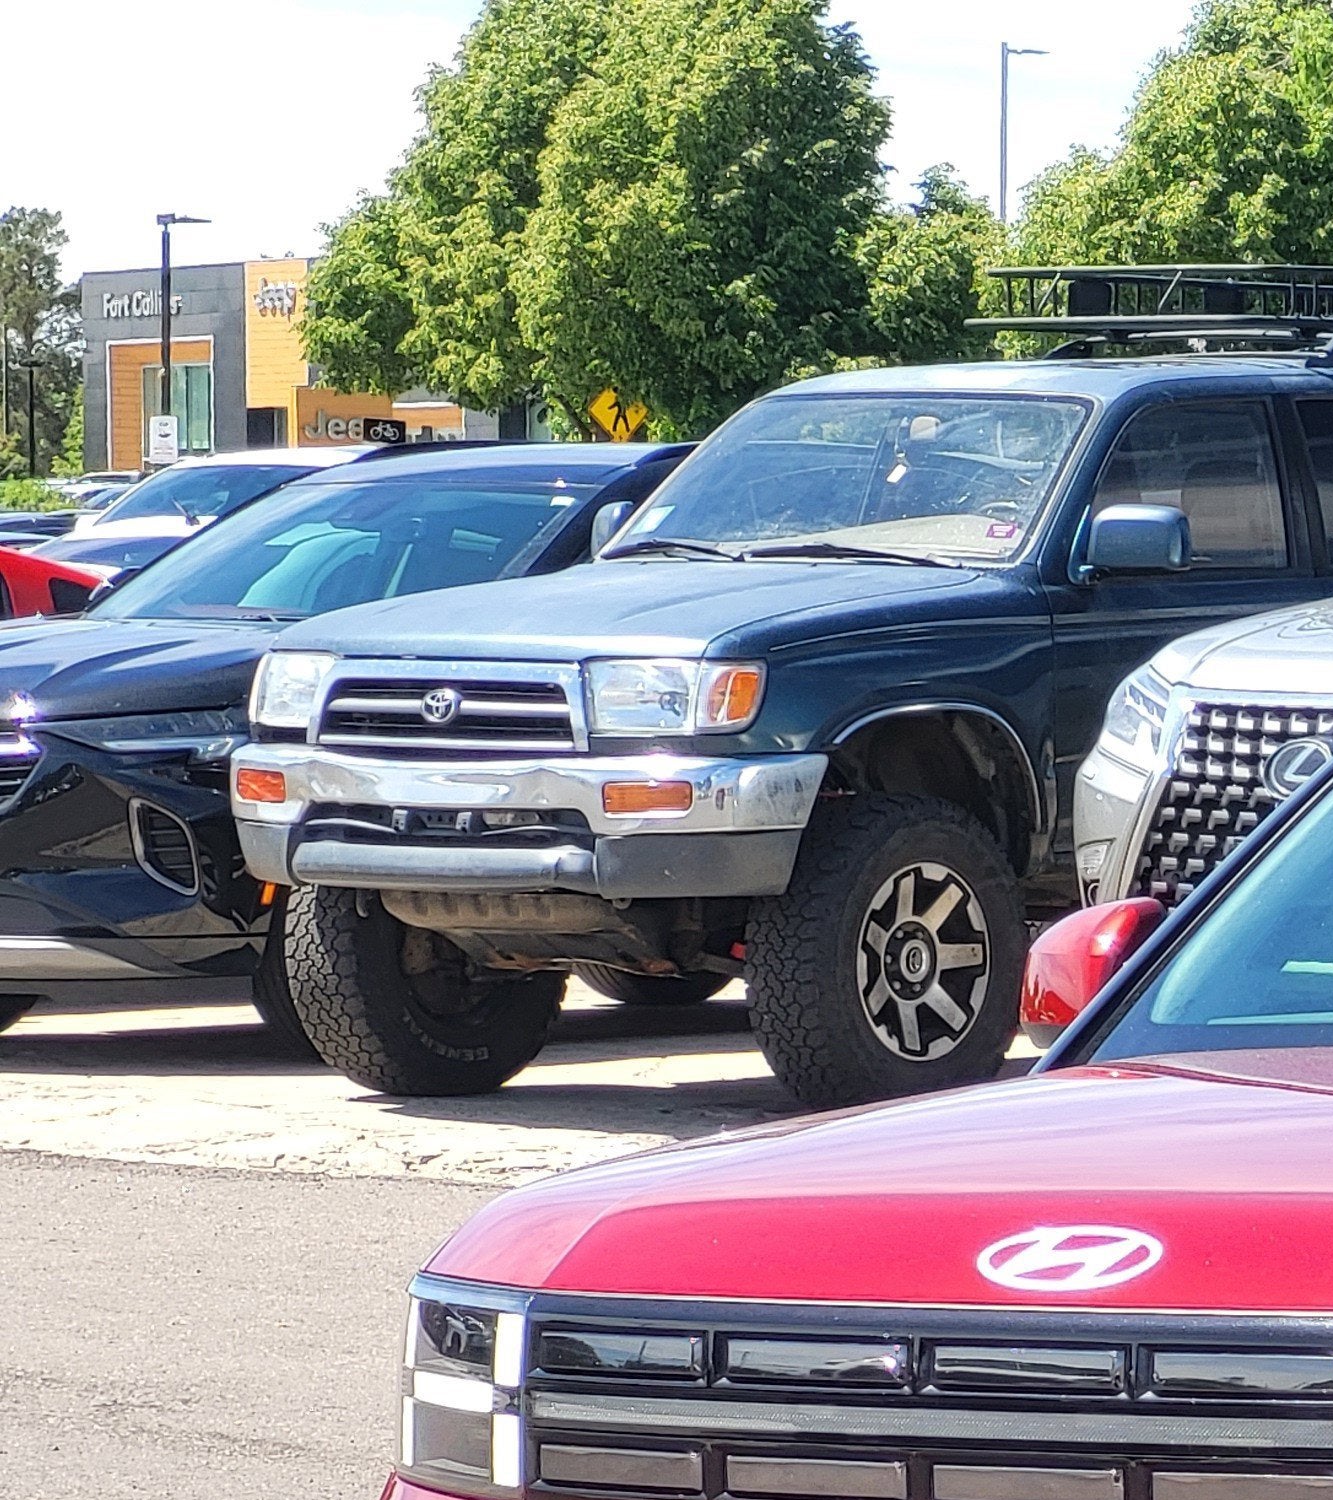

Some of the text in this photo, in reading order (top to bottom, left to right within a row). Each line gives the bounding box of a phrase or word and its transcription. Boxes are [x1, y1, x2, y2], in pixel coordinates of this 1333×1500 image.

[103, 289, 183, 318] Fort Collis
[304, 409, 363, 441] Jee
